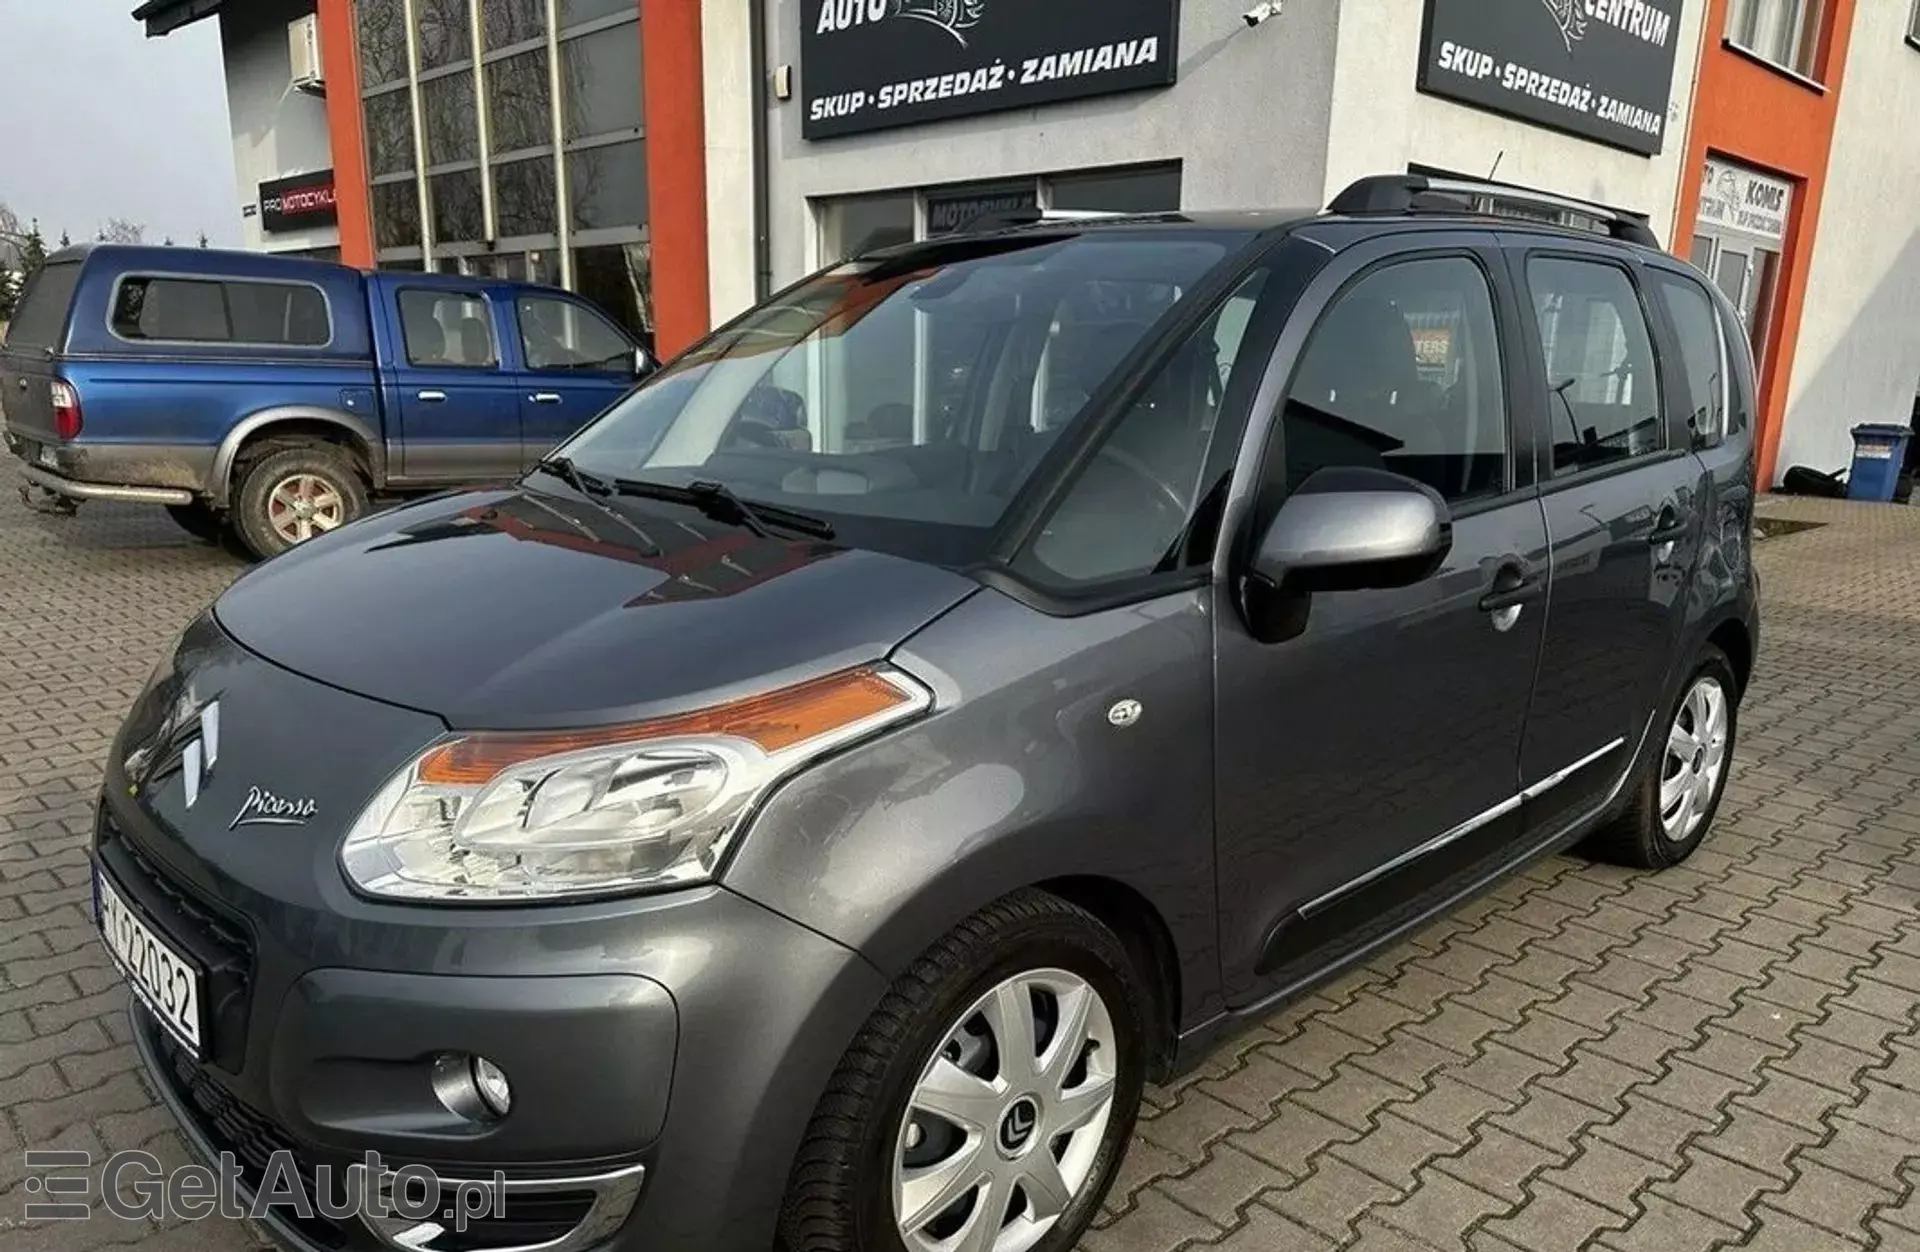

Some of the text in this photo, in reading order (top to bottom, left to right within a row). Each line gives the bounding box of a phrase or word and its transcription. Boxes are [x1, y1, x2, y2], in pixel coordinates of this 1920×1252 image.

[817, 0, 887, 34] AUTO
[810, 36, 1158, 120] SKUP SPRZEDAŻ ZAMIANA
[1438, 41, 1664, 135] SKUP SPRZEDAŻ ZAMIANA
[1745, 180, 1785, 212] KOMIS
[228, 784, 319, 830] Picasso
